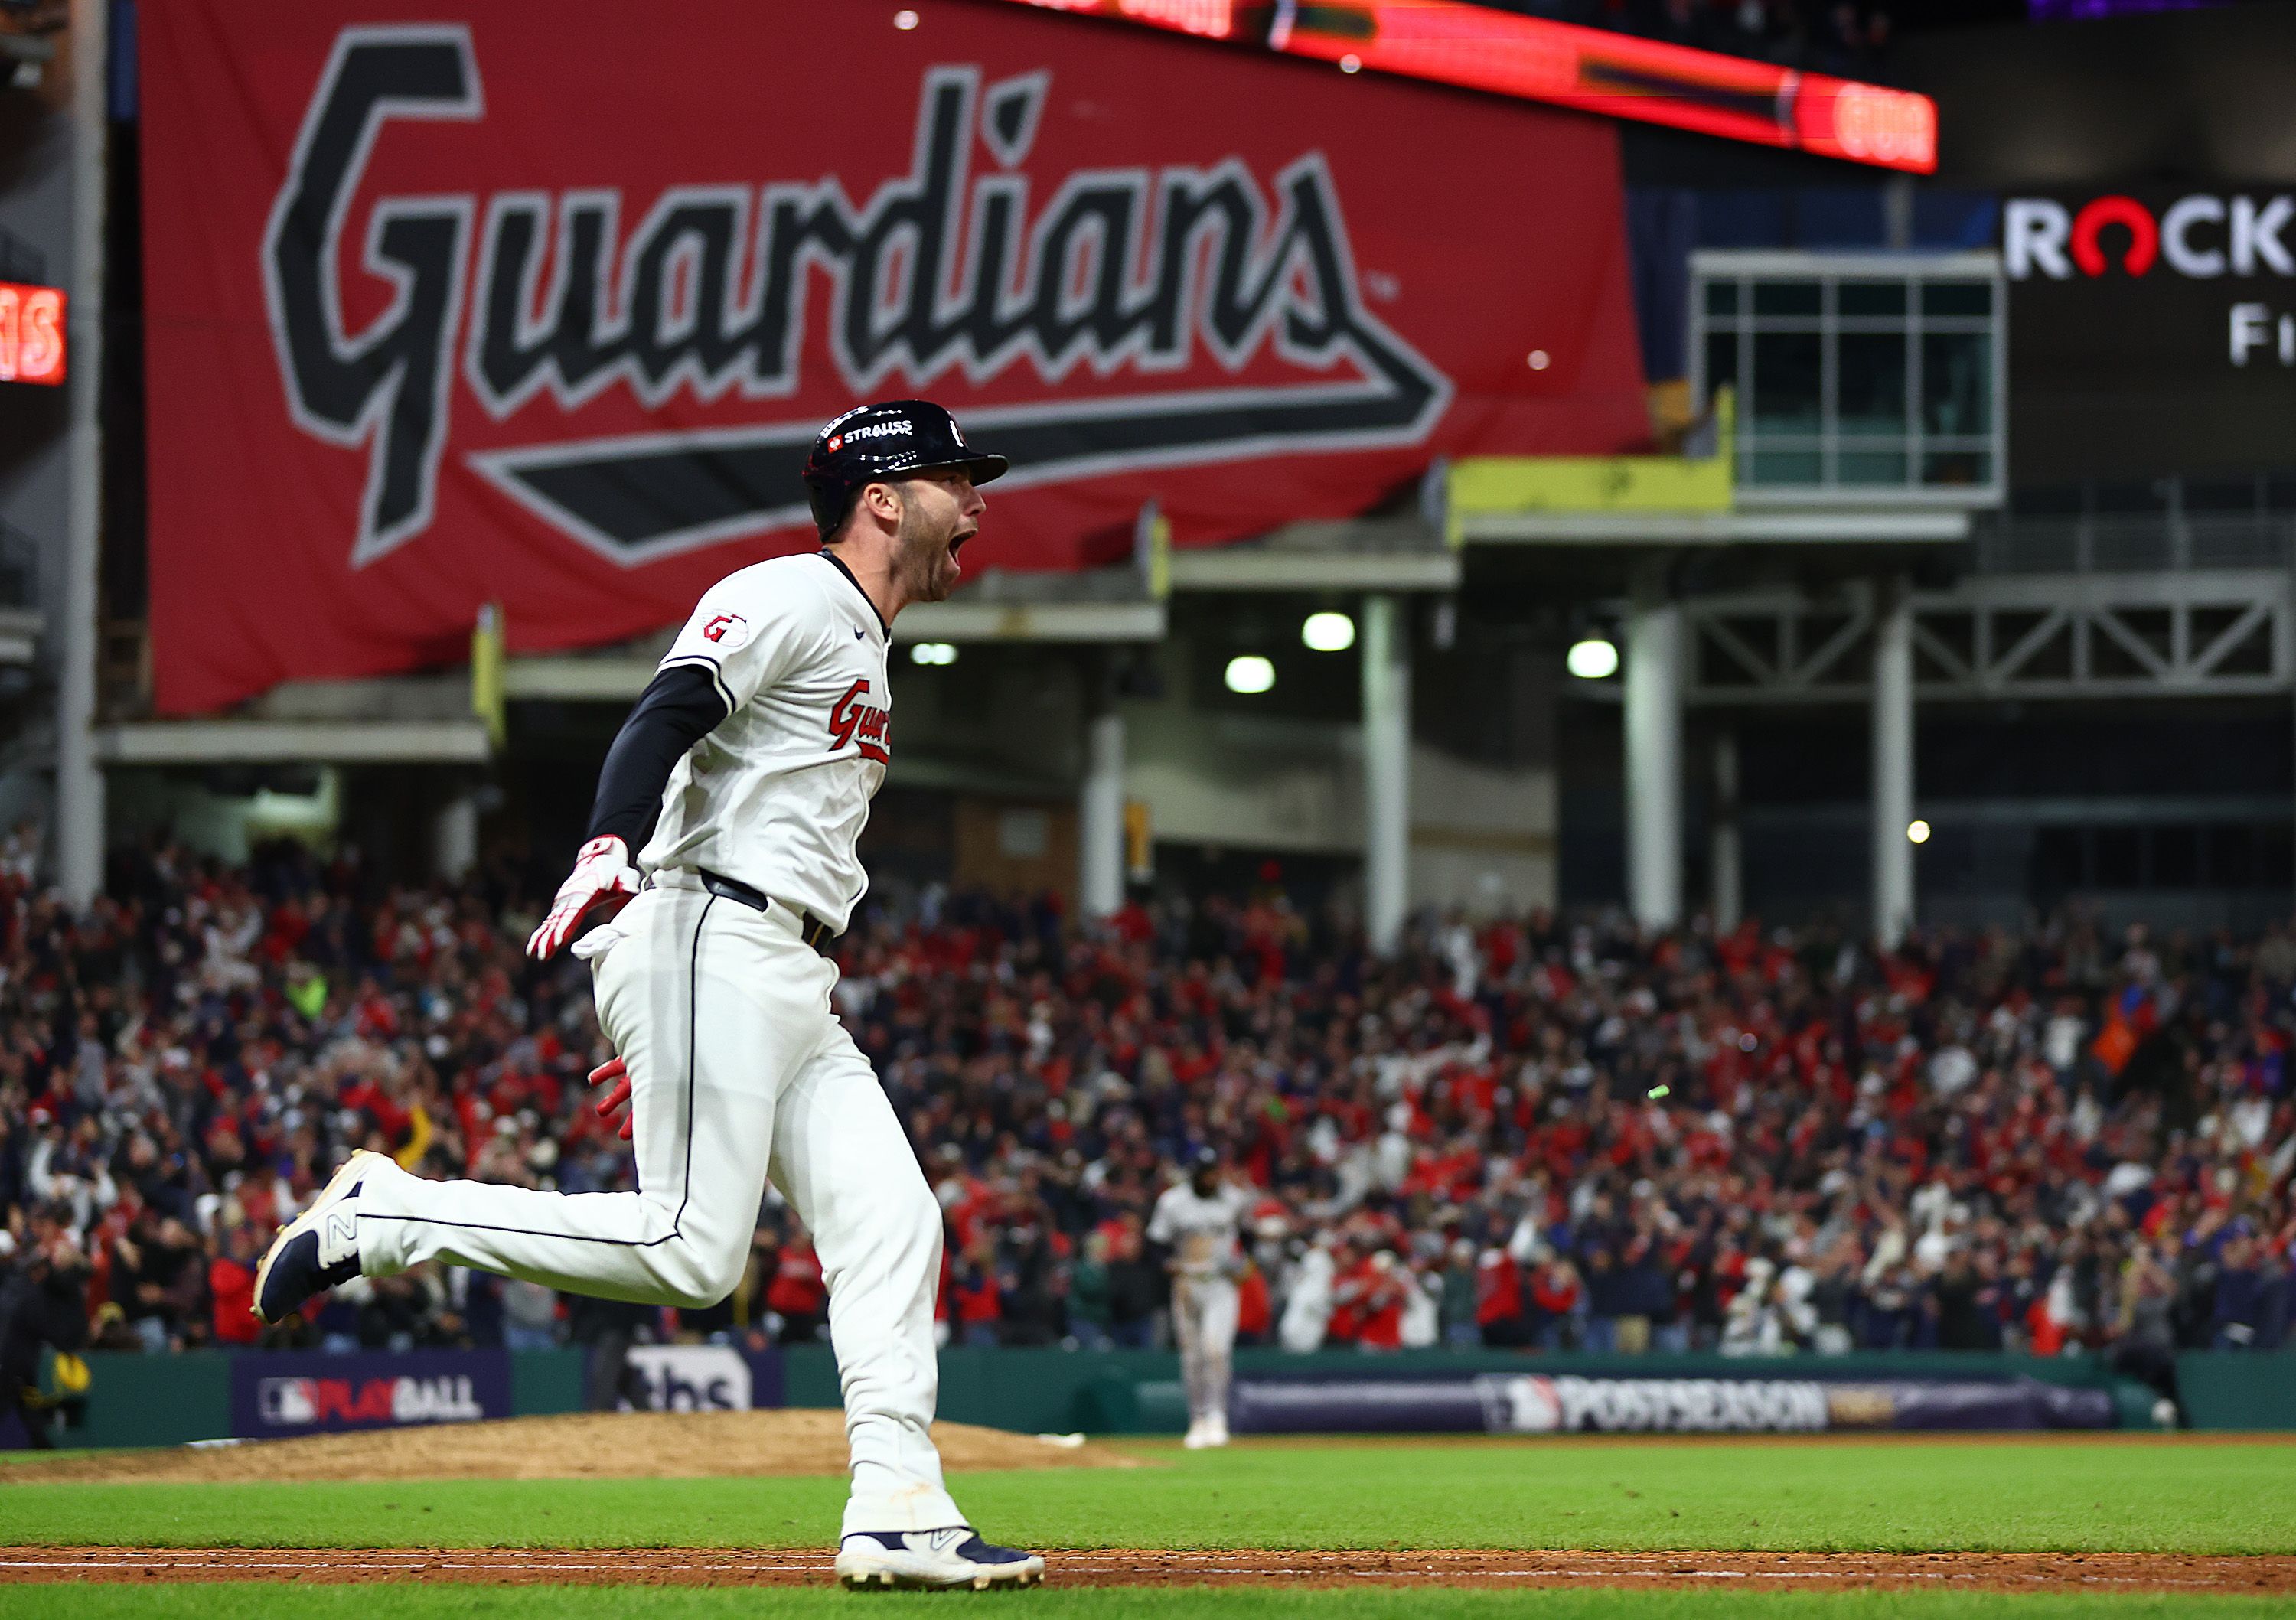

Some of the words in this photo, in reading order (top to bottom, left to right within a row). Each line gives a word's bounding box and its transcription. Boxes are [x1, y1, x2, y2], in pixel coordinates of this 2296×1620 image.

[2004, 193, 2296, 279] ROCK
[260, 23, 1366, 570] Guardians
[844, 420, 912, 444] STRAUSS
[1557, 1375, 1828, 1429] POSTSEASON
